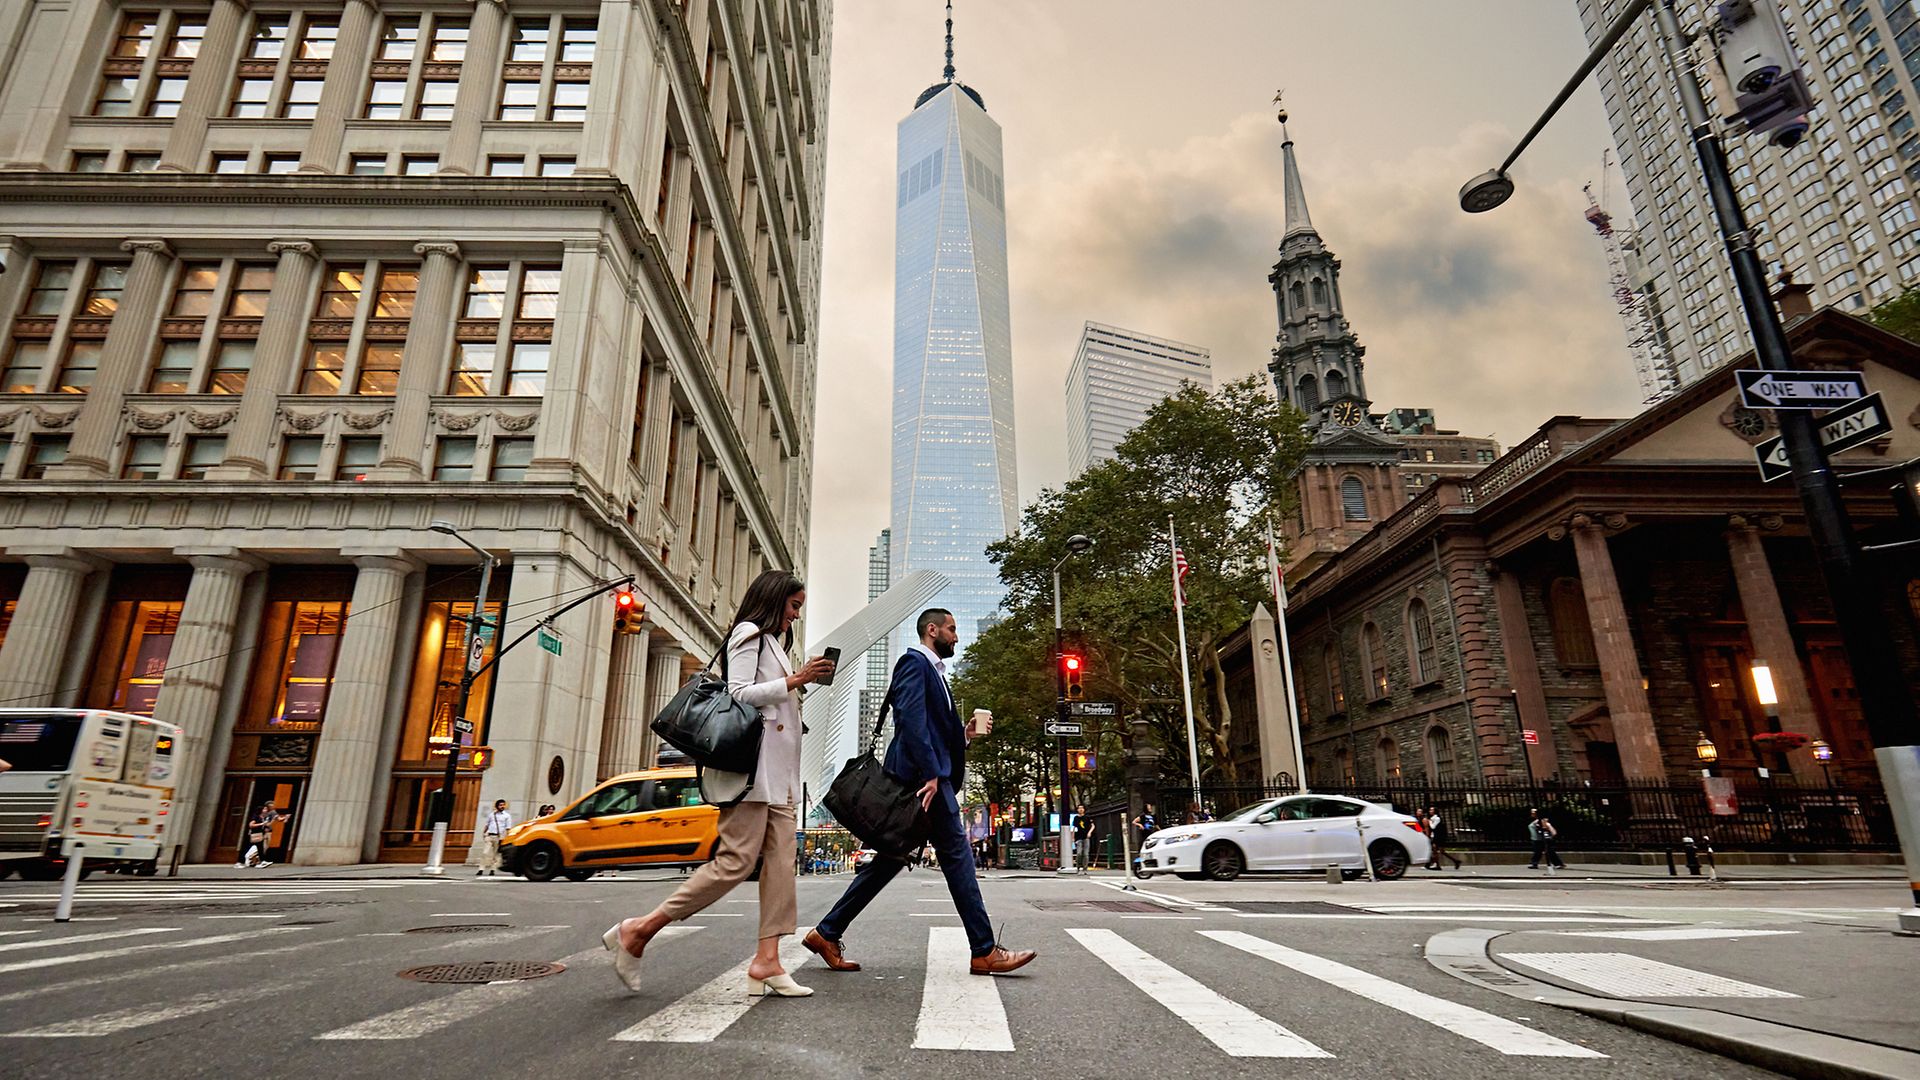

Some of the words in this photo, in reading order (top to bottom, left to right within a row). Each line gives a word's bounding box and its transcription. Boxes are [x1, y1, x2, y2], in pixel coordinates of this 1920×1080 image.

[1759, 382, 1797, 397] ONE
[1811, 383, 1850, 397] WAY
[1825, 412, 1868, 442] WAY
[1084, 705, 1113, 715] Broadway
